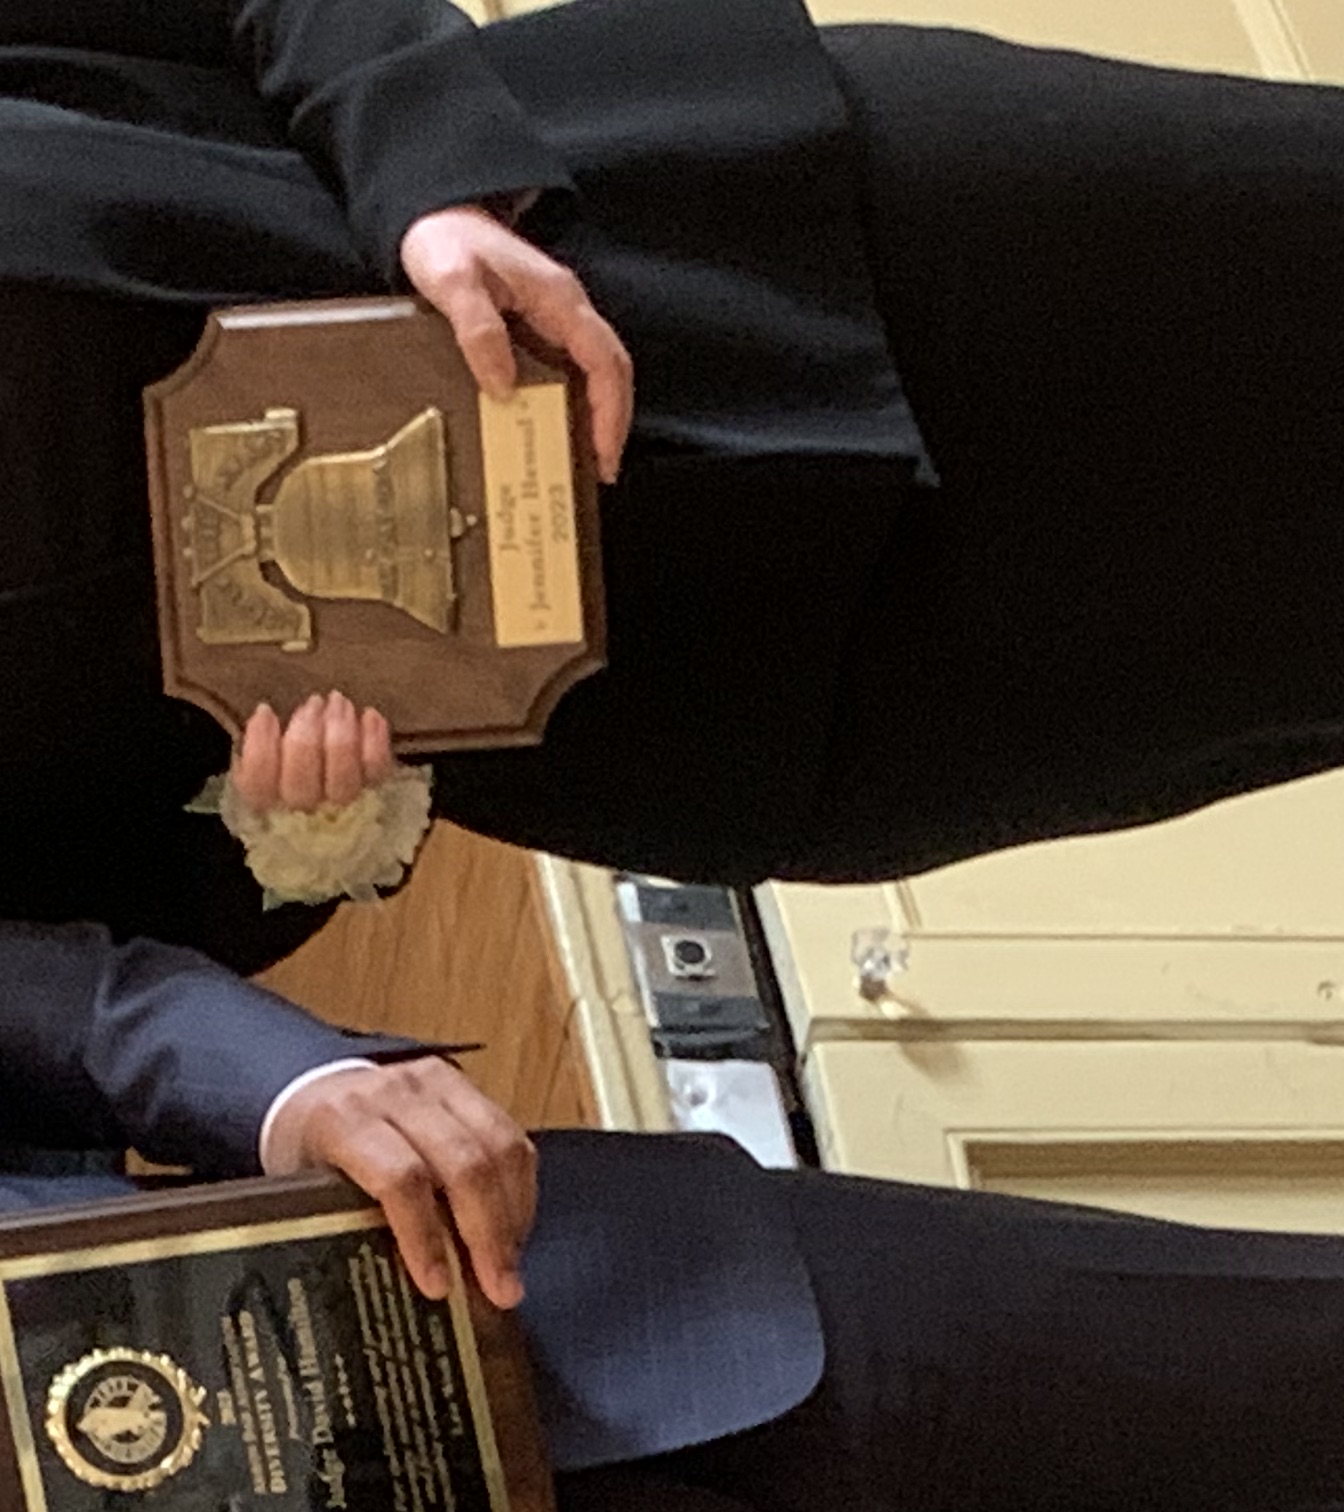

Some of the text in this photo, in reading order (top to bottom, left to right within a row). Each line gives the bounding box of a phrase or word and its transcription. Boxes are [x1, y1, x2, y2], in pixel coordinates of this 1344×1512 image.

[494, 484, 519, 551] Judge
[546, 483, 569, 543] 2023
[522, 514, 550, 611] Jennifer
[285, 1277, 321, 1373] Hamilton
[237, 1309, 287, 1494] DIVERSITY AWARD
[304, 1381, 334, 1444] David
